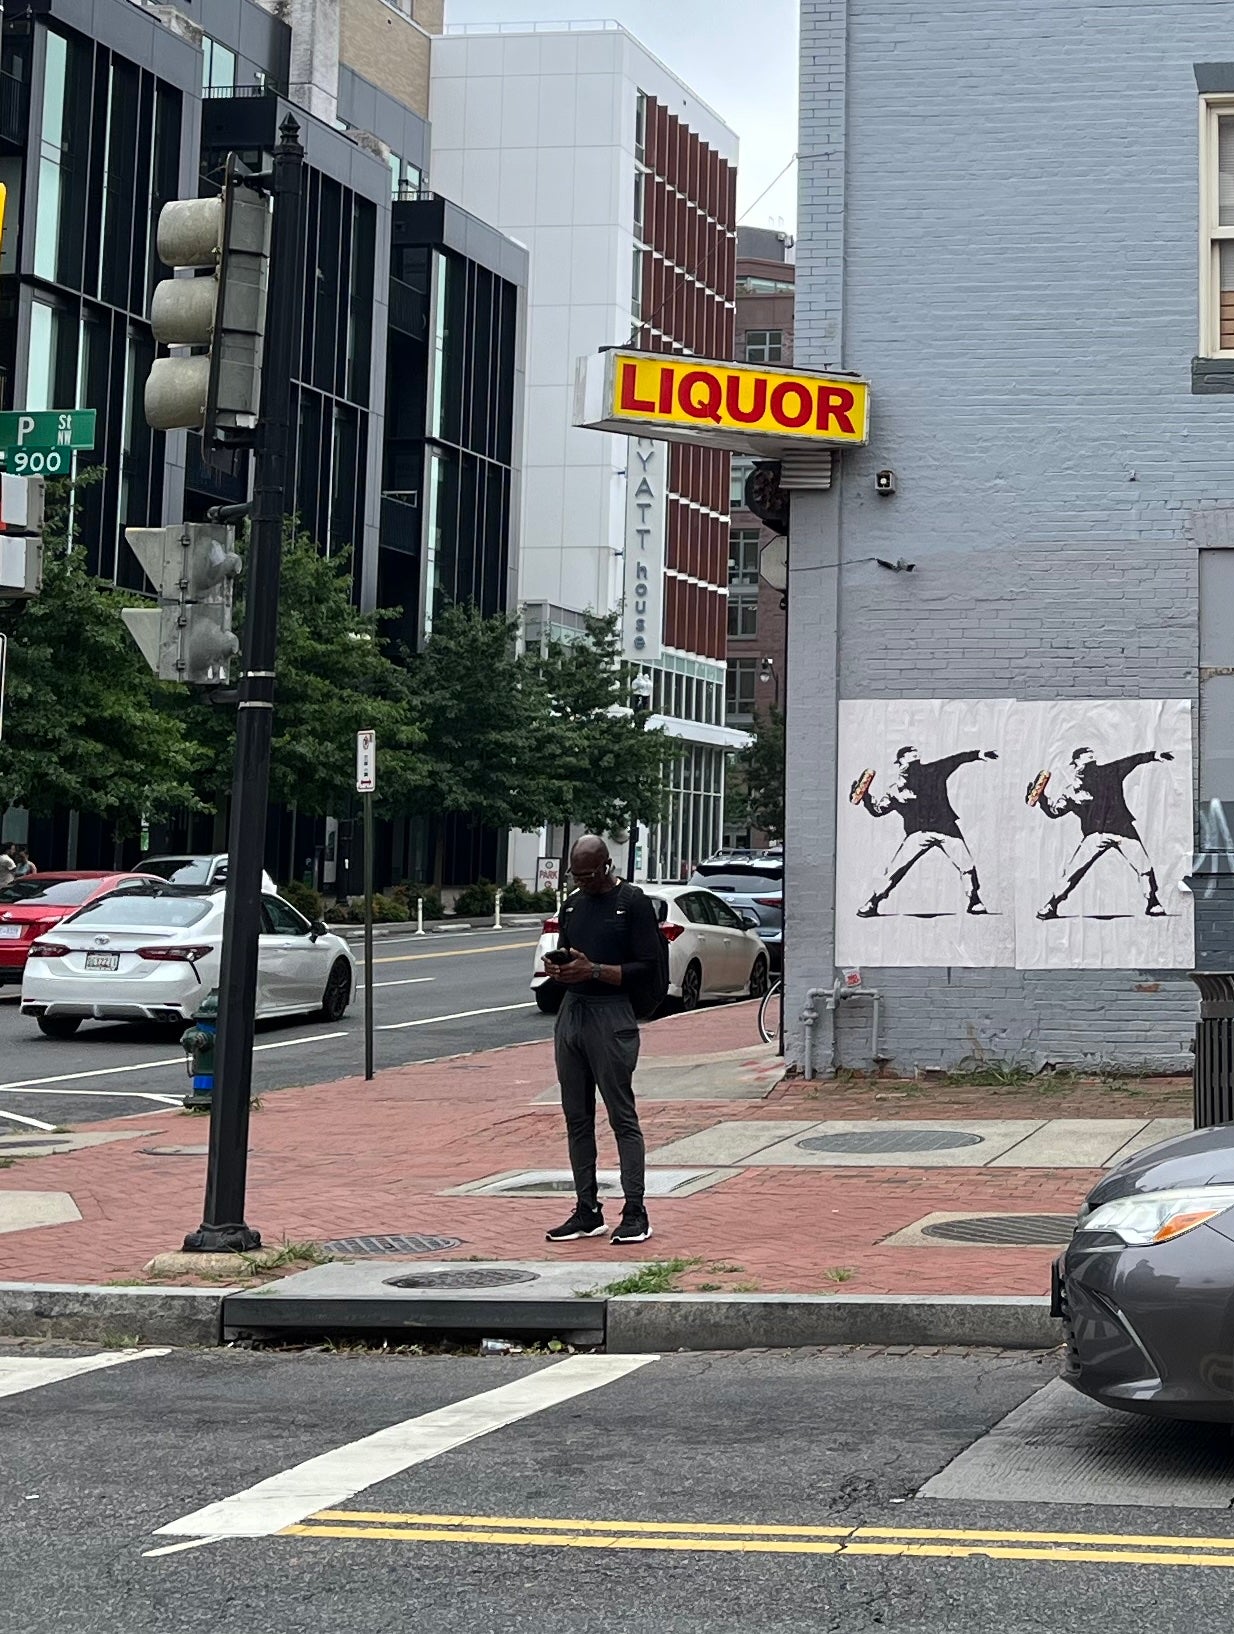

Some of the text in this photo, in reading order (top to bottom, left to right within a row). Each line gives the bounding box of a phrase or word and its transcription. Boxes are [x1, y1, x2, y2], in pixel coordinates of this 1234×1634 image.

[620, 363, 856, 433] LIQUOR
[17, 414, 72, 446] P St
[57, 430, 72, 445] NW
[14, 452, 61, 472] 900
[634, 561, 648, 650] house
[539, 869, 558, 880] PARK
